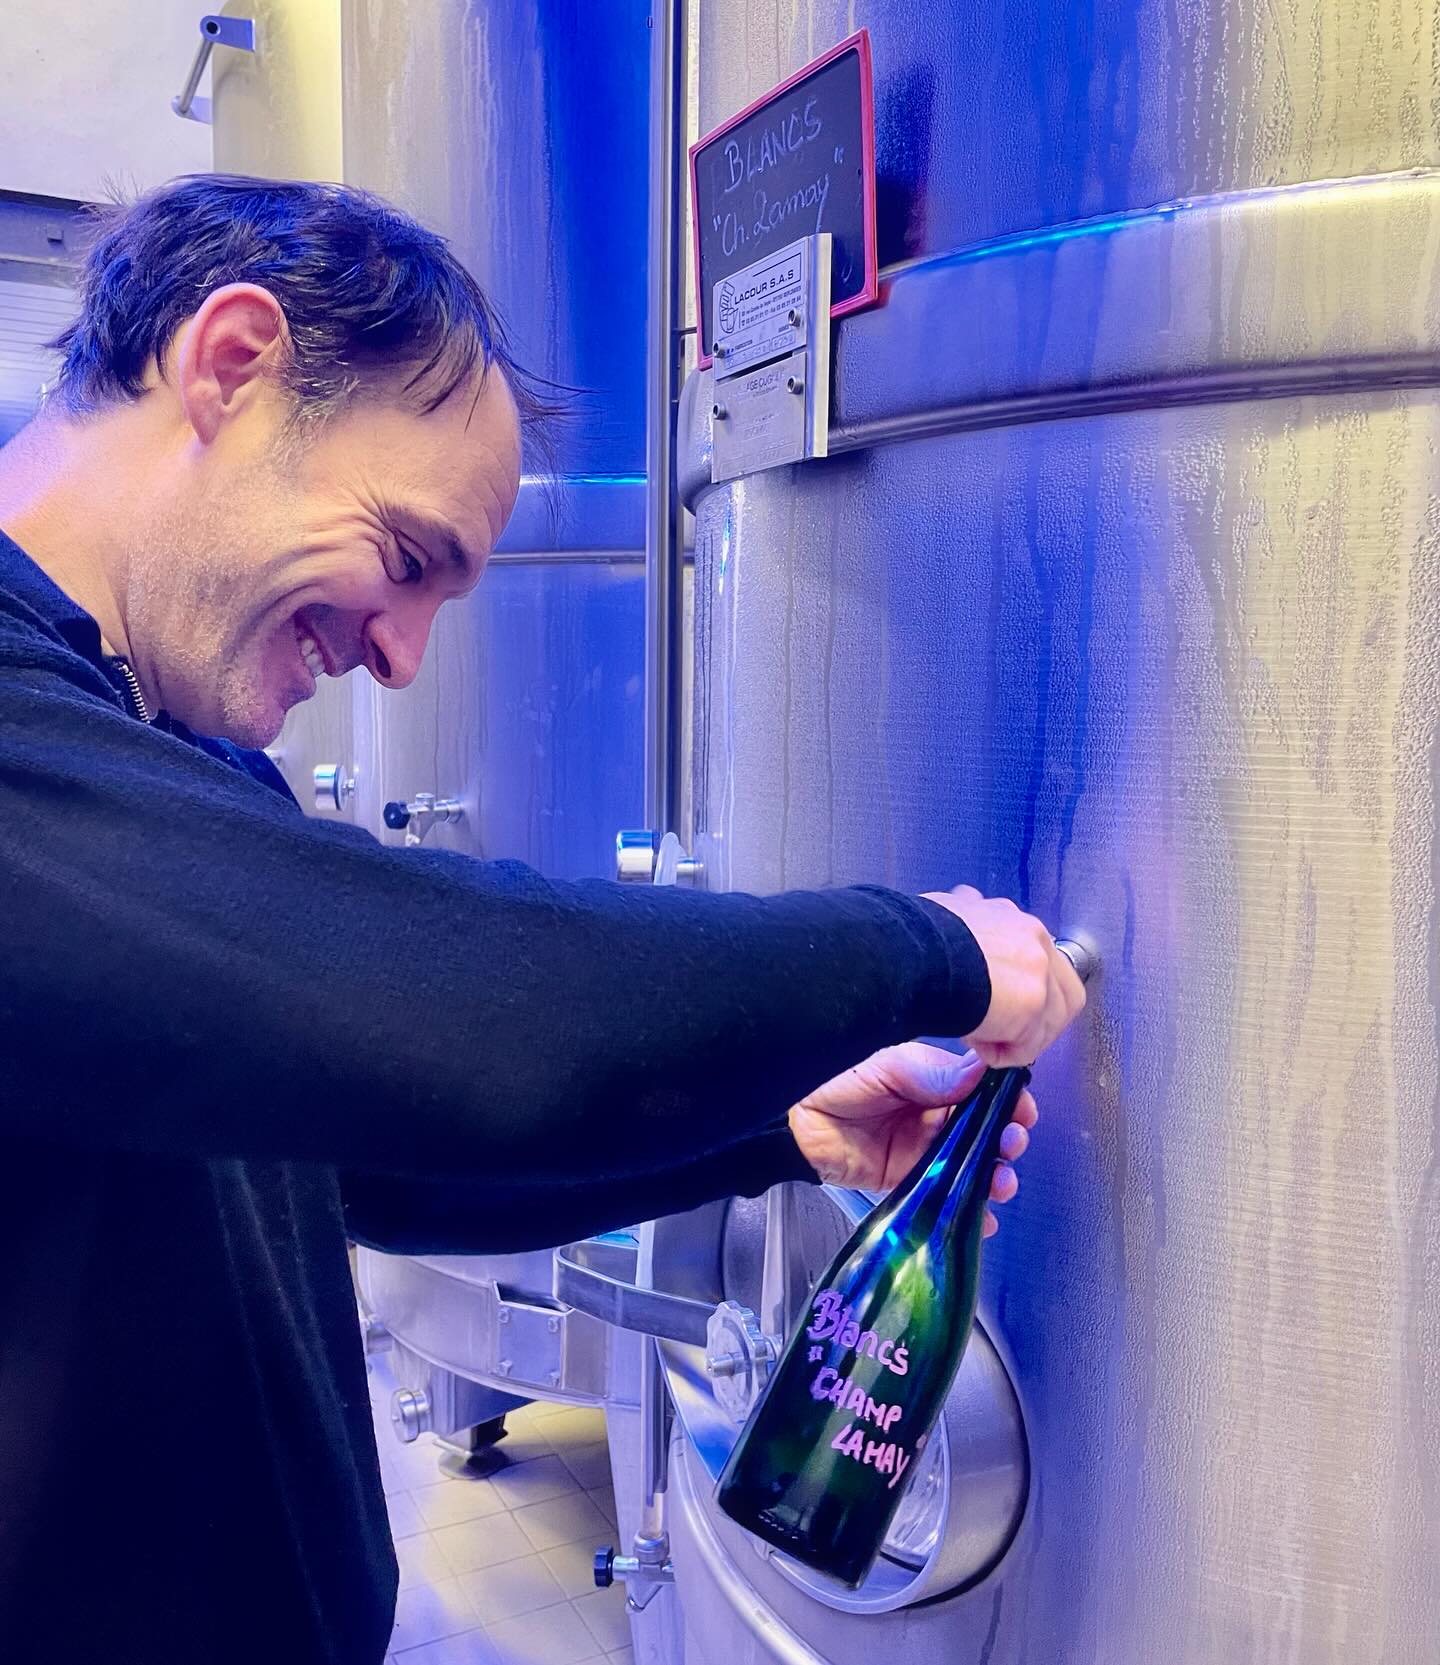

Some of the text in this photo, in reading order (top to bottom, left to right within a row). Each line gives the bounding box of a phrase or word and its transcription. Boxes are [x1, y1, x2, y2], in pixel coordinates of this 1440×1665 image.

[724, 99, 822, 193] BLANCS
[734, 282, 768, 305] LACOUR
[807, 1289, 909, 1376] Blancs
